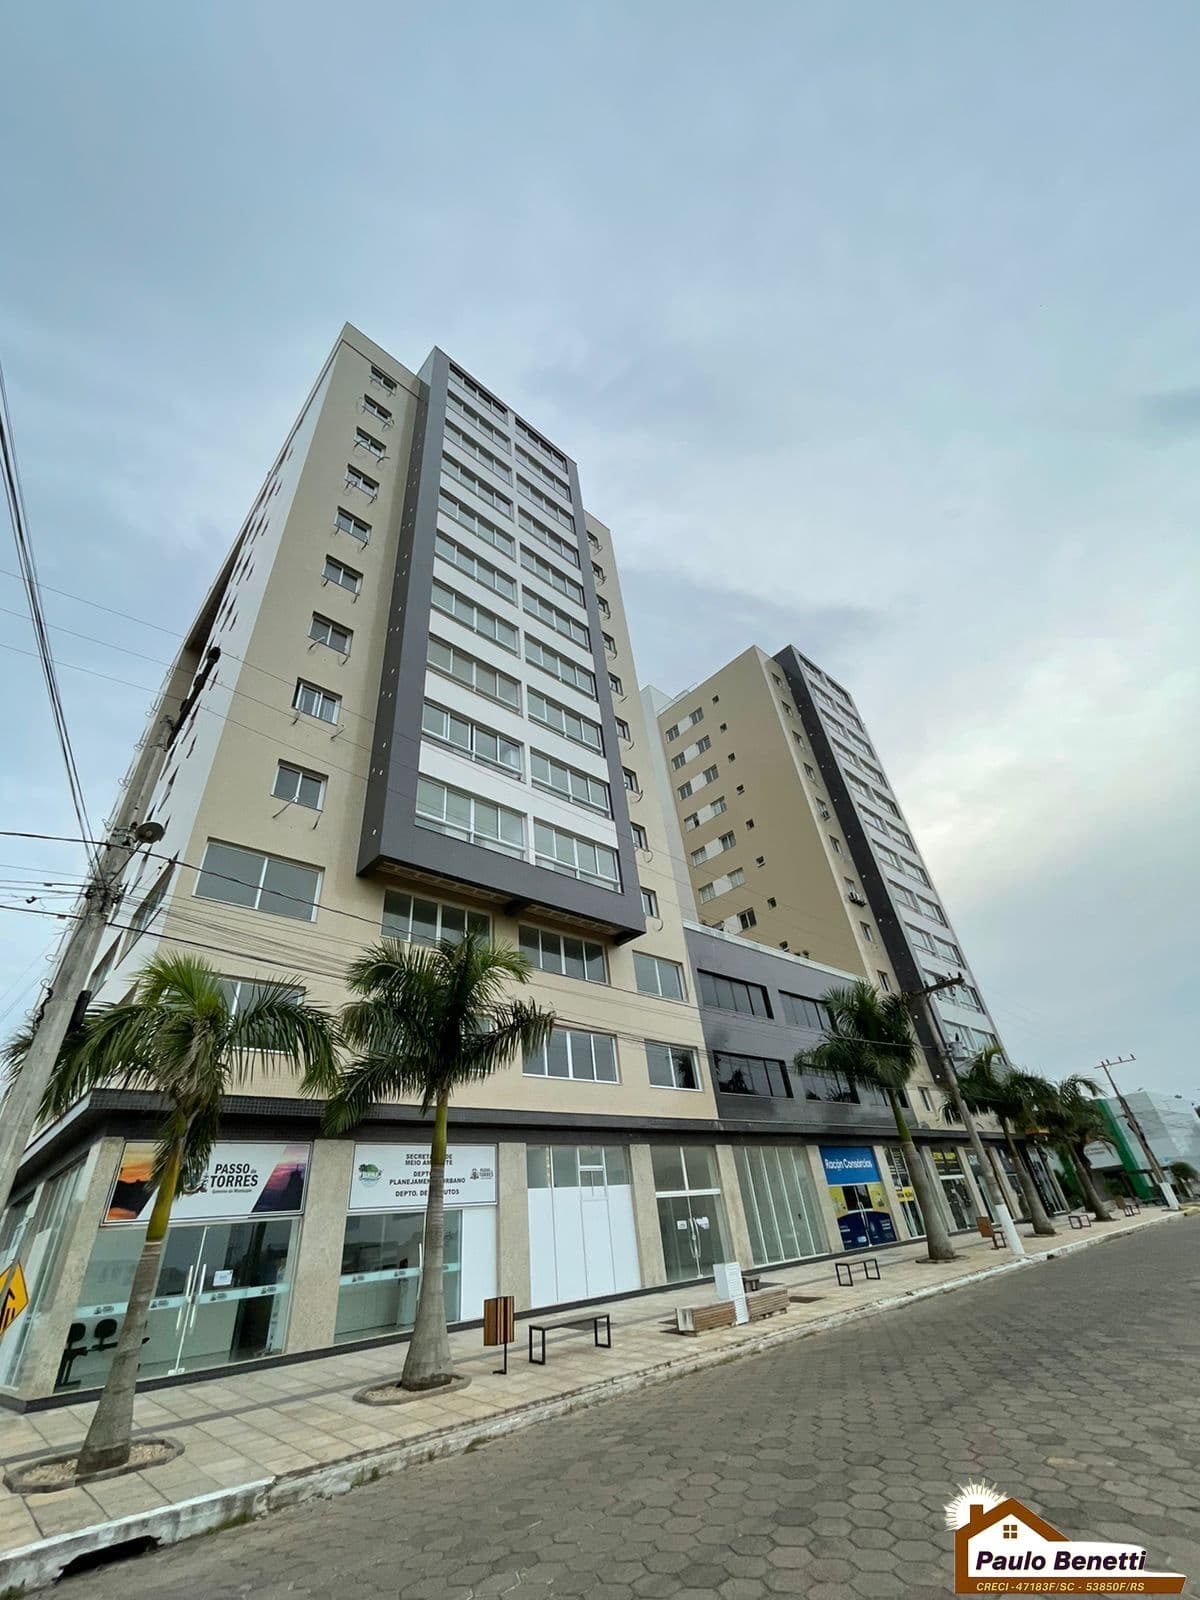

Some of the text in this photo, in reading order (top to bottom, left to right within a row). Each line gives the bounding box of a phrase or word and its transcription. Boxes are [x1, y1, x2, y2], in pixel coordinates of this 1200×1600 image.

[215, 1163, 250, 1174] PASSO
[210, 1175, 258, 1187] TORRES
[419, 1189, 428, 1197] DE
